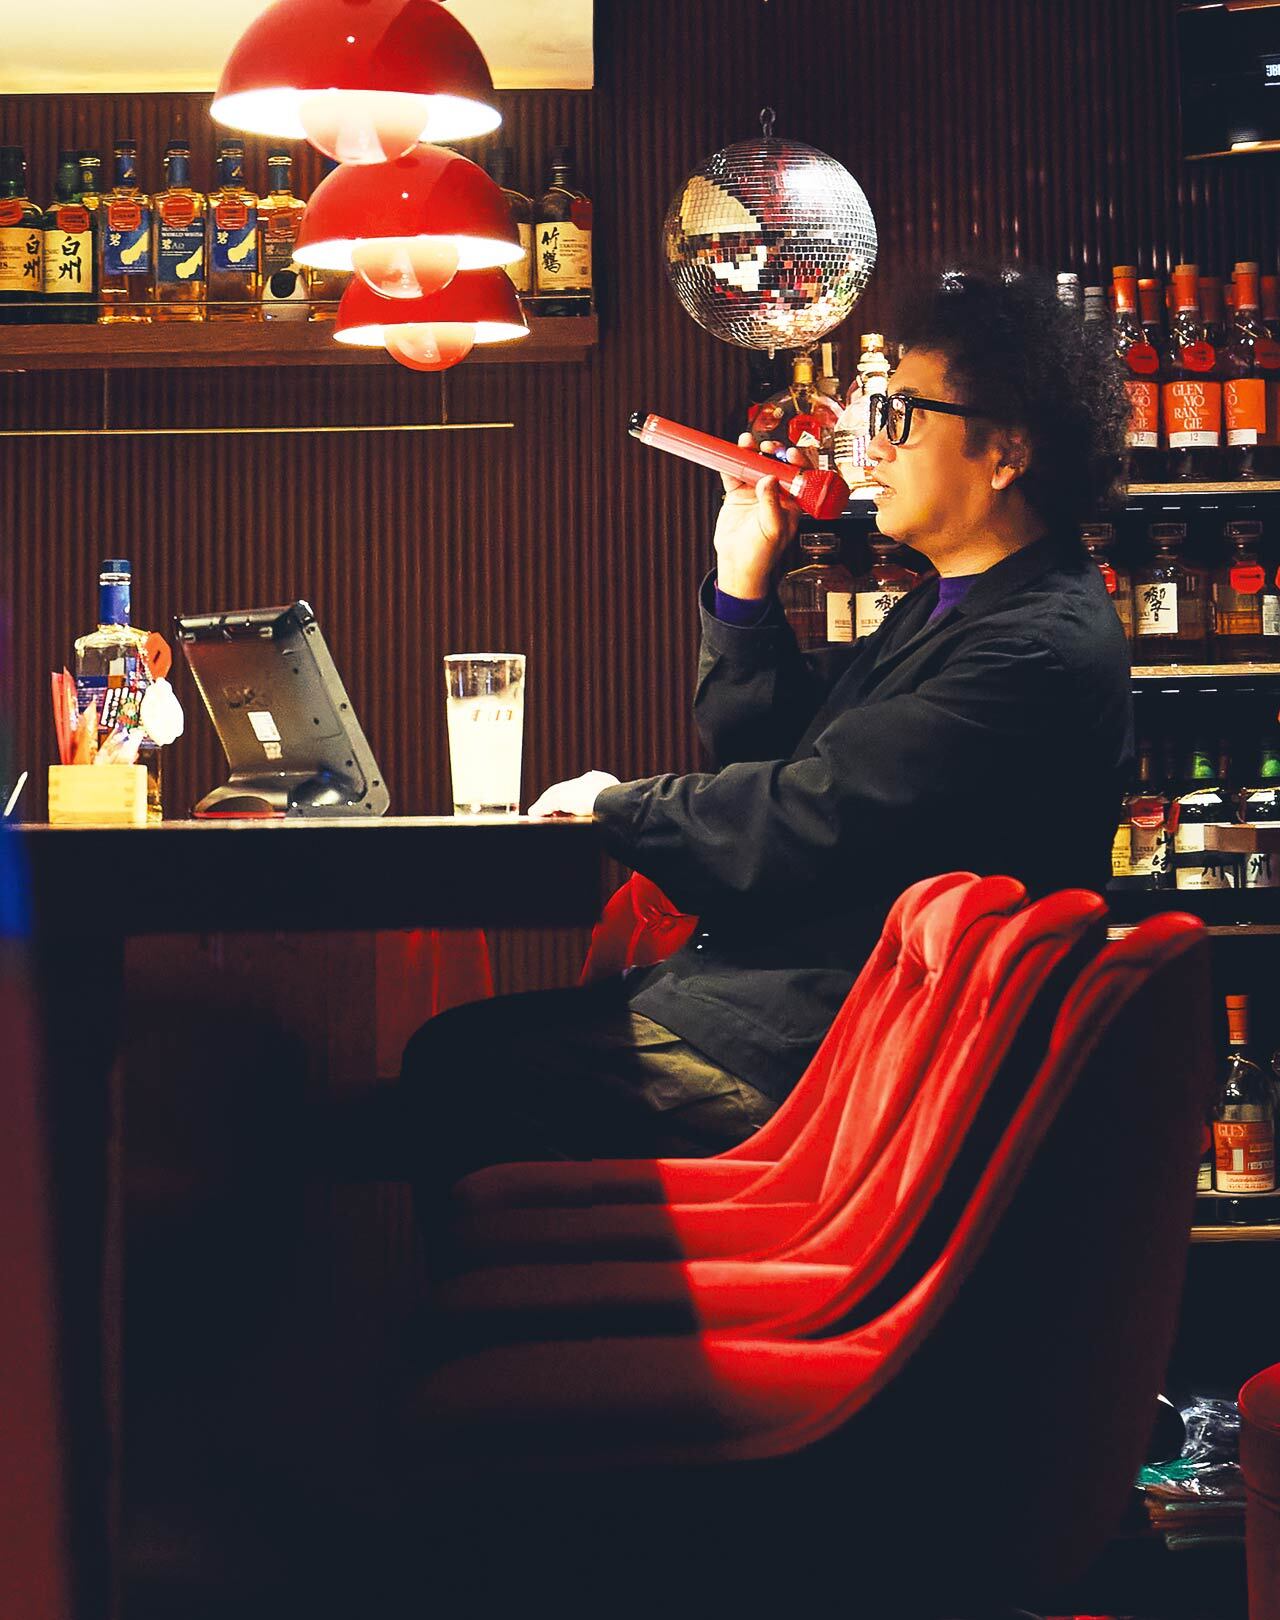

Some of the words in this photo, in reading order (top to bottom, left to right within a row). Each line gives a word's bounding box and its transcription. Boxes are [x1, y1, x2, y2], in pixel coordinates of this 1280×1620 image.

[541, 226, 562, 274] 竹鶴
[24, 233, 41, 283] 白州
[58, 235, 82, 284] 白州
[1172, 384, 1204, 397] GLEN
[1183, 395, 1205, 408] MO
[1174, 406, 1198, 419] RAN
[1183, 417, 1203, 430] GIE
[1190, 432, 1199, 442] 12
[1143, 585, 1171, 622] 響
